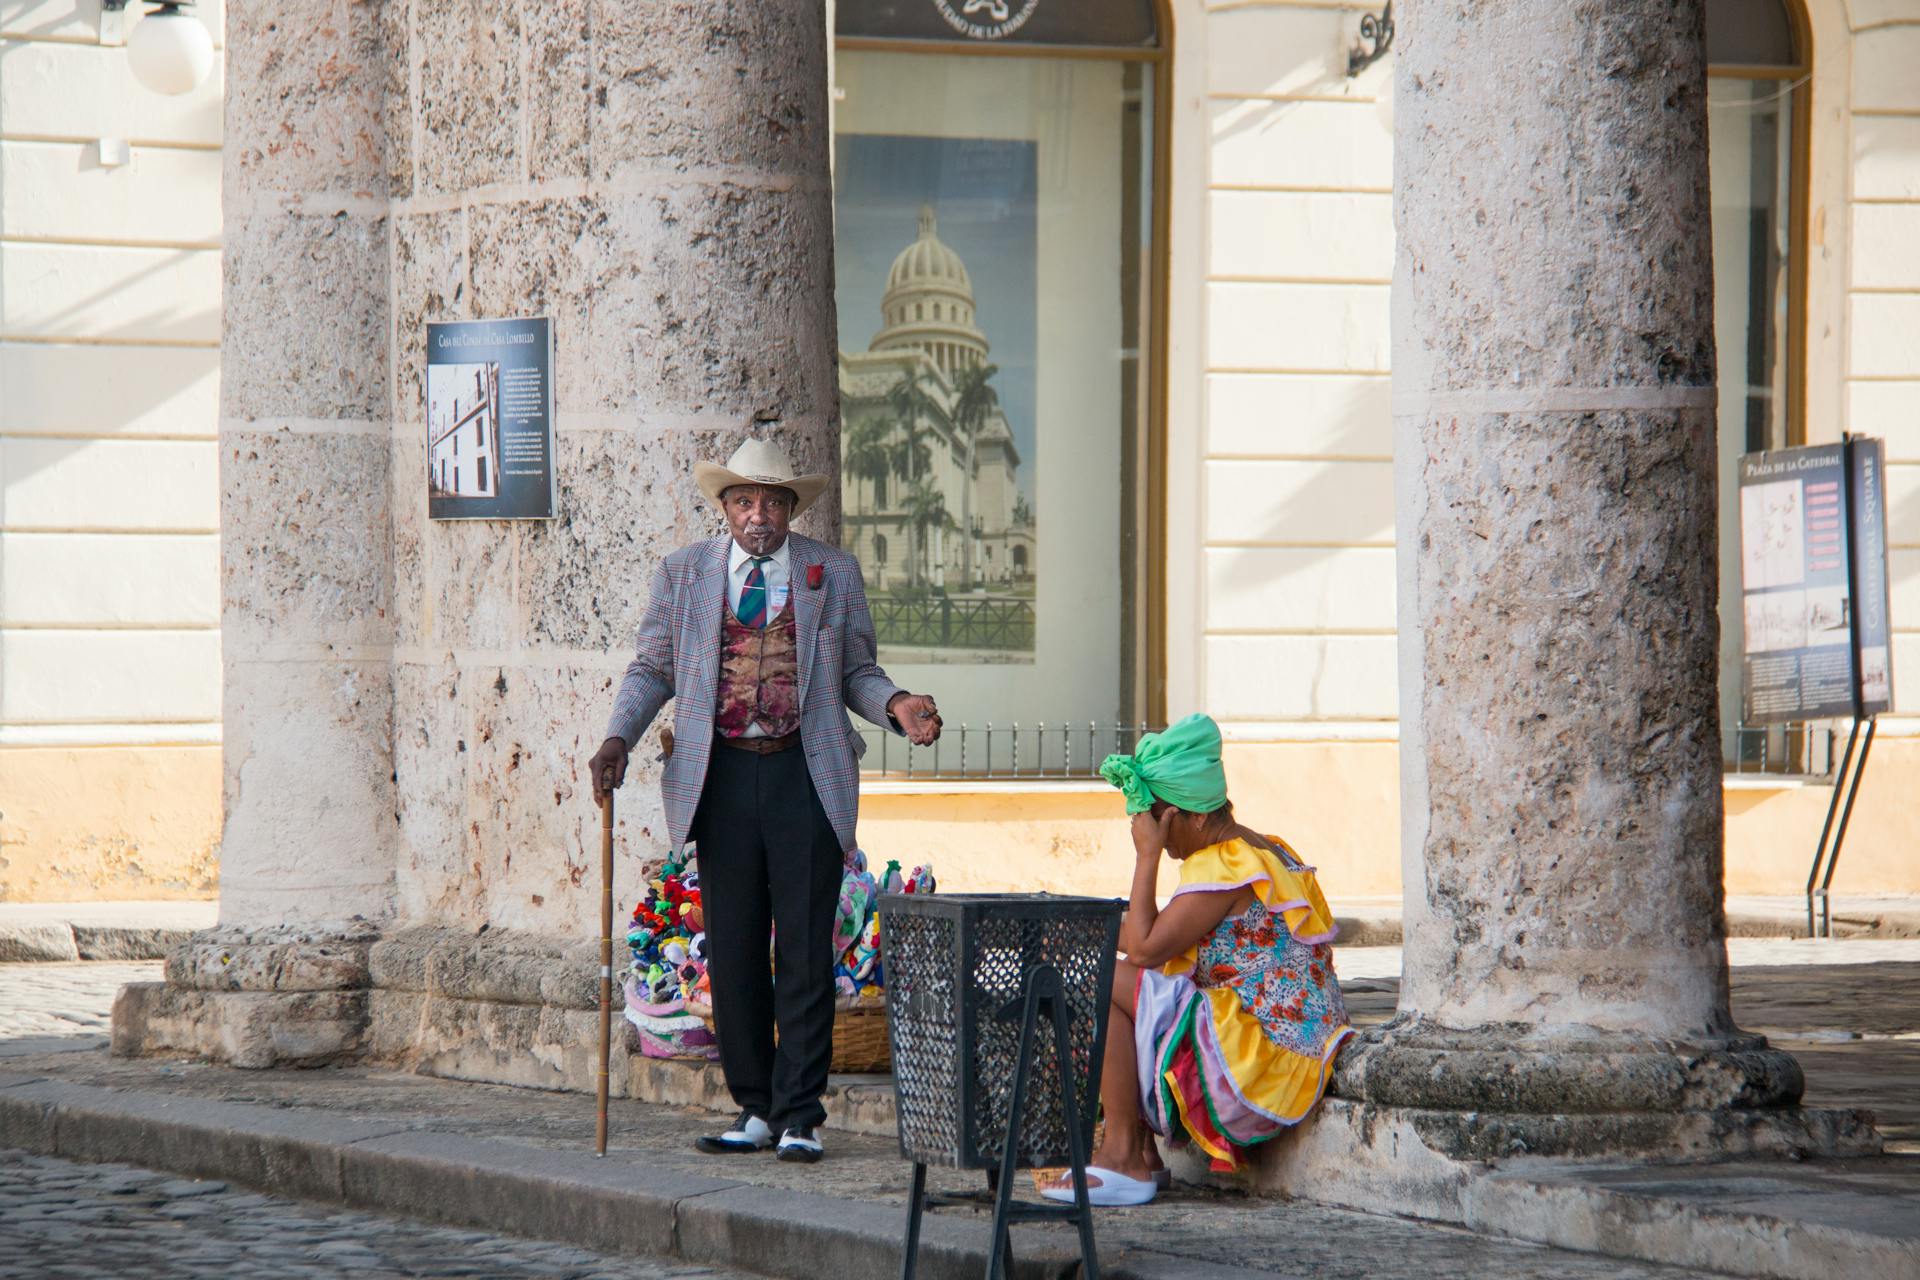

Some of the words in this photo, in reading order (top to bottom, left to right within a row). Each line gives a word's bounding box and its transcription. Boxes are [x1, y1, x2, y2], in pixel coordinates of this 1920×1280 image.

[986, 25, 1002, 39] LA
[438, 333, 452, 347] CASA
[1747, 463, 1773, 477] PLAZA
[1774, 462, 1785, 473] DE
[1786, 460, 1797, 472] LA
[1797, 455, 1840, 470] CATEDRAL
[1863, 456, 1877, 524] SQUARE
[1865, 529, 1879, 629] CATHEDRAL
